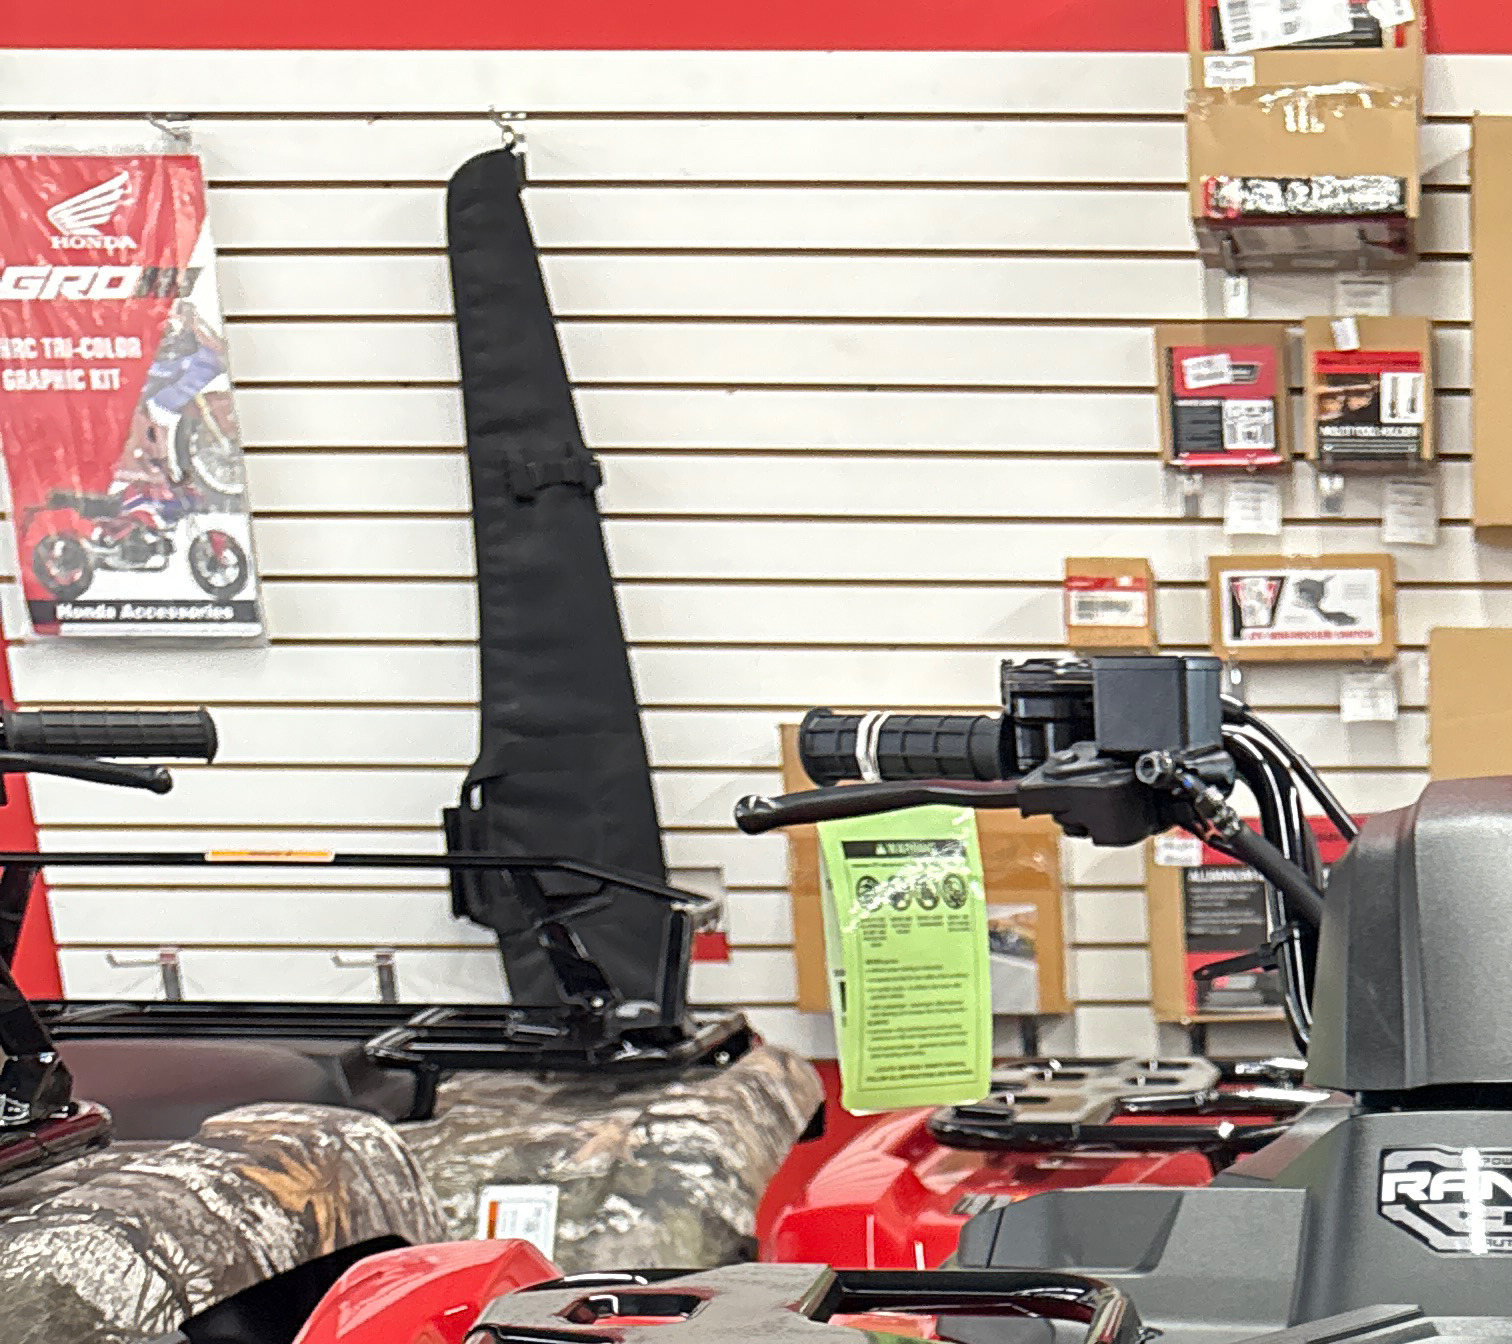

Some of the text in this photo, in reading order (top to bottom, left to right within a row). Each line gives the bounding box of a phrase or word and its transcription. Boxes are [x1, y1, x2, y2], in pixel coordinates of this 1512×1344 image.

[51, 235, 137, 249] HONDA
[40, 336, 143, 359] TRI-COLOR
[2, 368, 120, 391] GRAPHIC KIT
[56, 603, 235, 621] Honda Accessories
